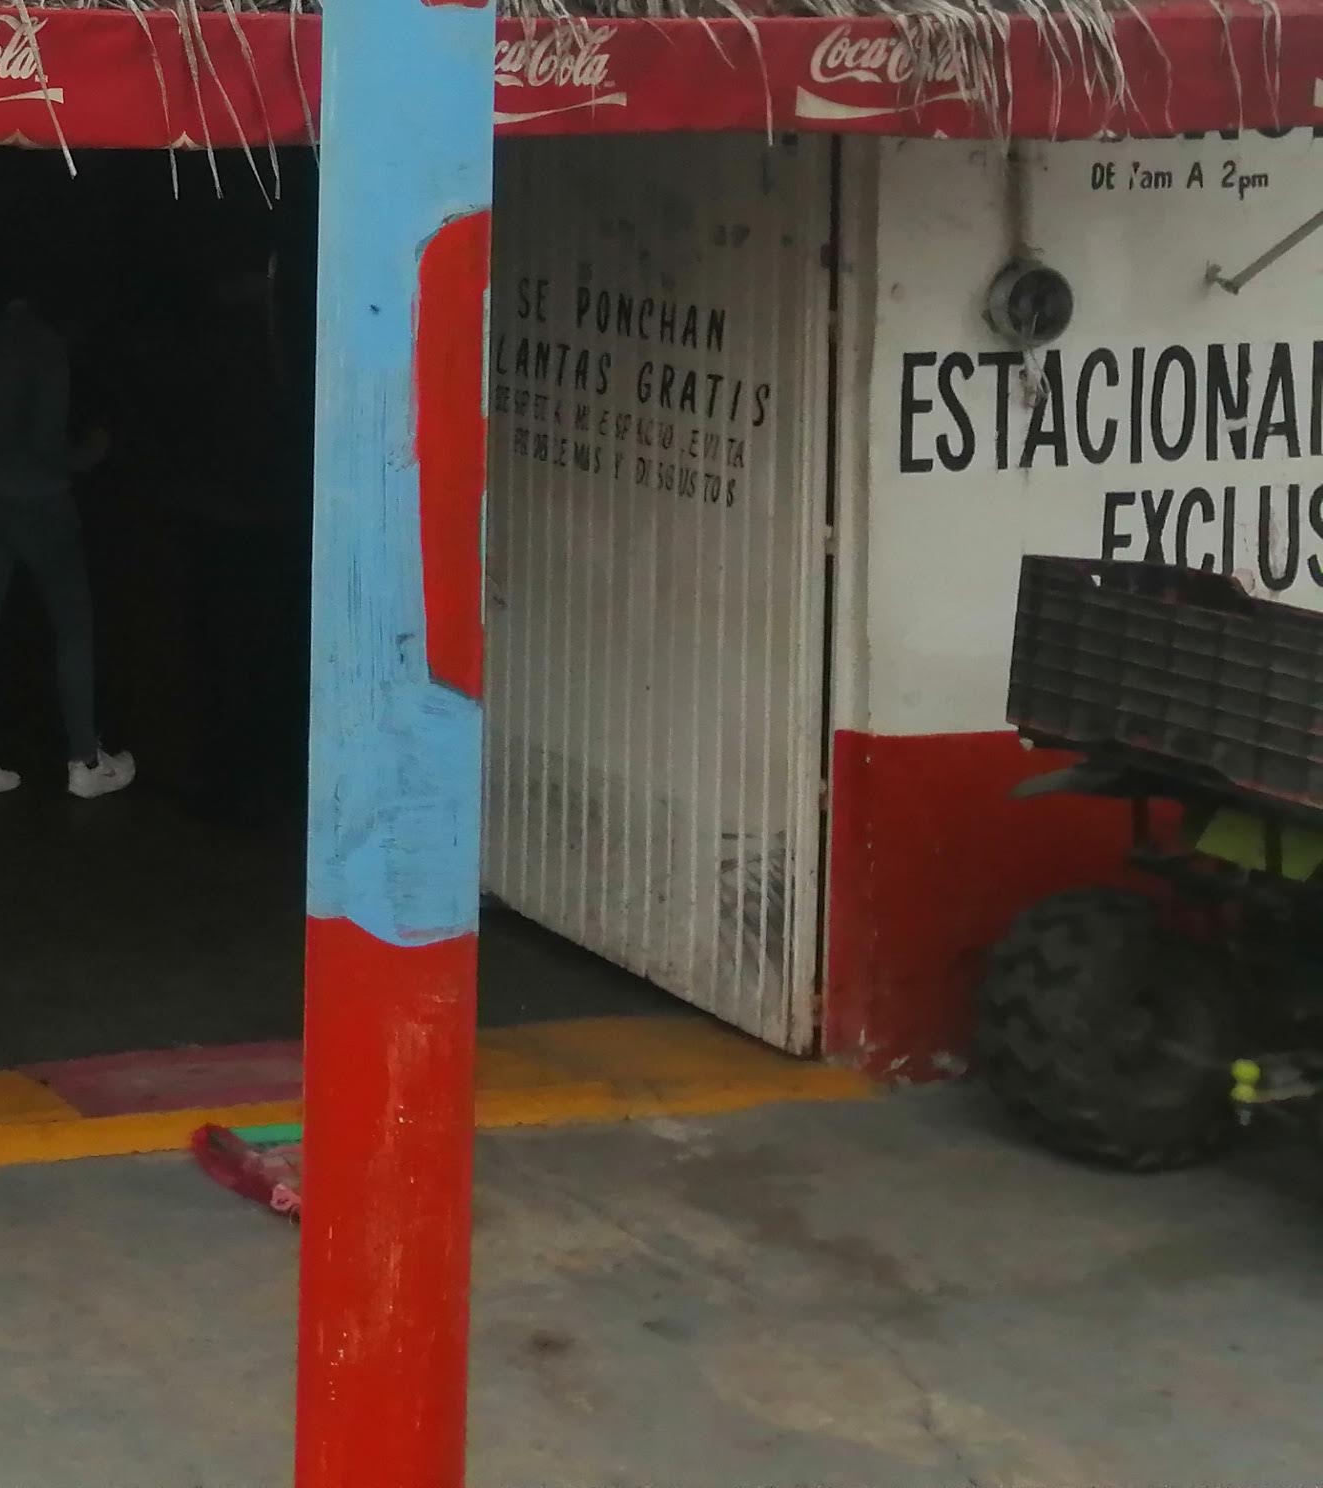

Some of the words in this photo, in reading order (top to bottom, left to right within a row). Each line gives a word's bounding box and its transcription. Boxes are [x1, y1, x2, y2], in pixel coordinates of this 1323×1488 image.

[1091, 161, 1116, 191] DE
[1186, 161, 1204, 189] A
[1221, 159, 1269, 201] 2pm
[516, 277, 550, 323] SE
[576, 286, 726, 352] PONCHAN
[636, 360, 770, 427] GRATIS
